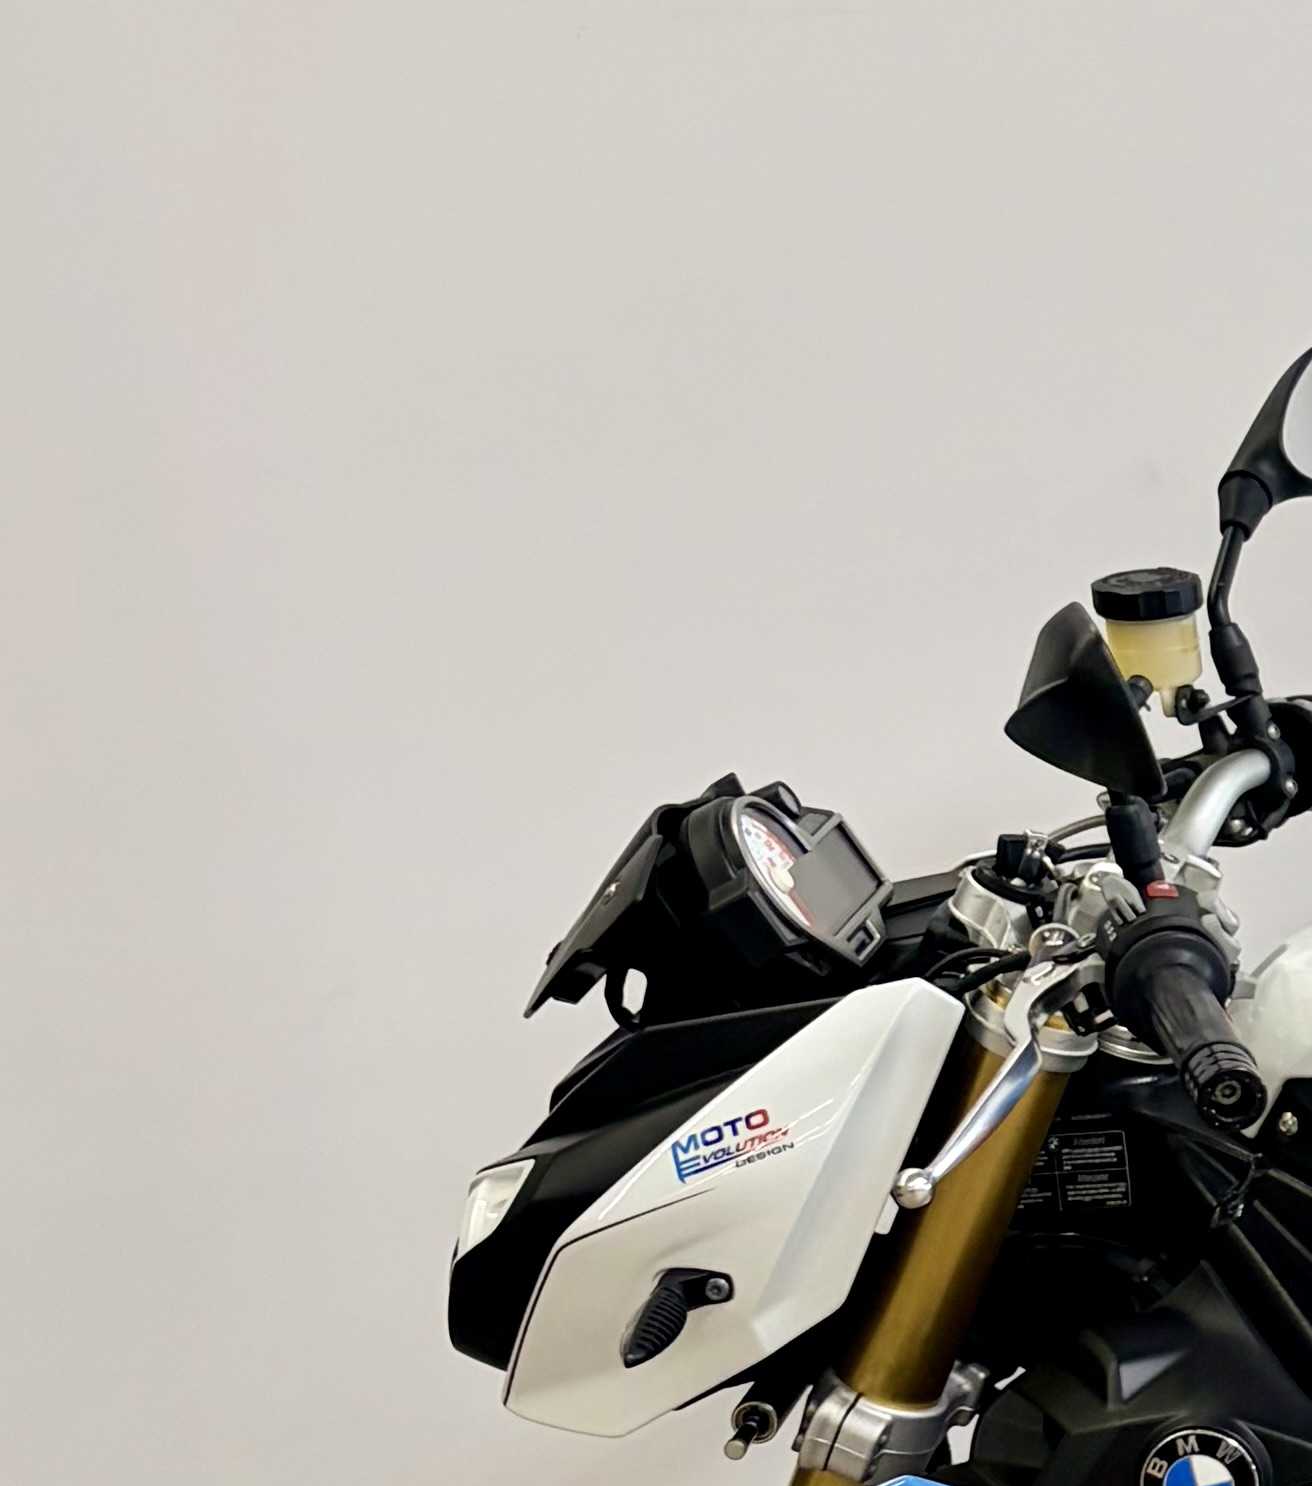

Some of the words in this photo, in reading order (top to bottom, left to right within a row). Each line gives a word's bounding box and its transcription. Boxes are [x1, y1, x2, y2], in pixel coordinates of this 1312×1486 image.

[671, 1108, 770, 1154] MOTO
[735, 1141, 795, 1168] DESIGN
[1146, 1434, 1242, 1479] BMW
